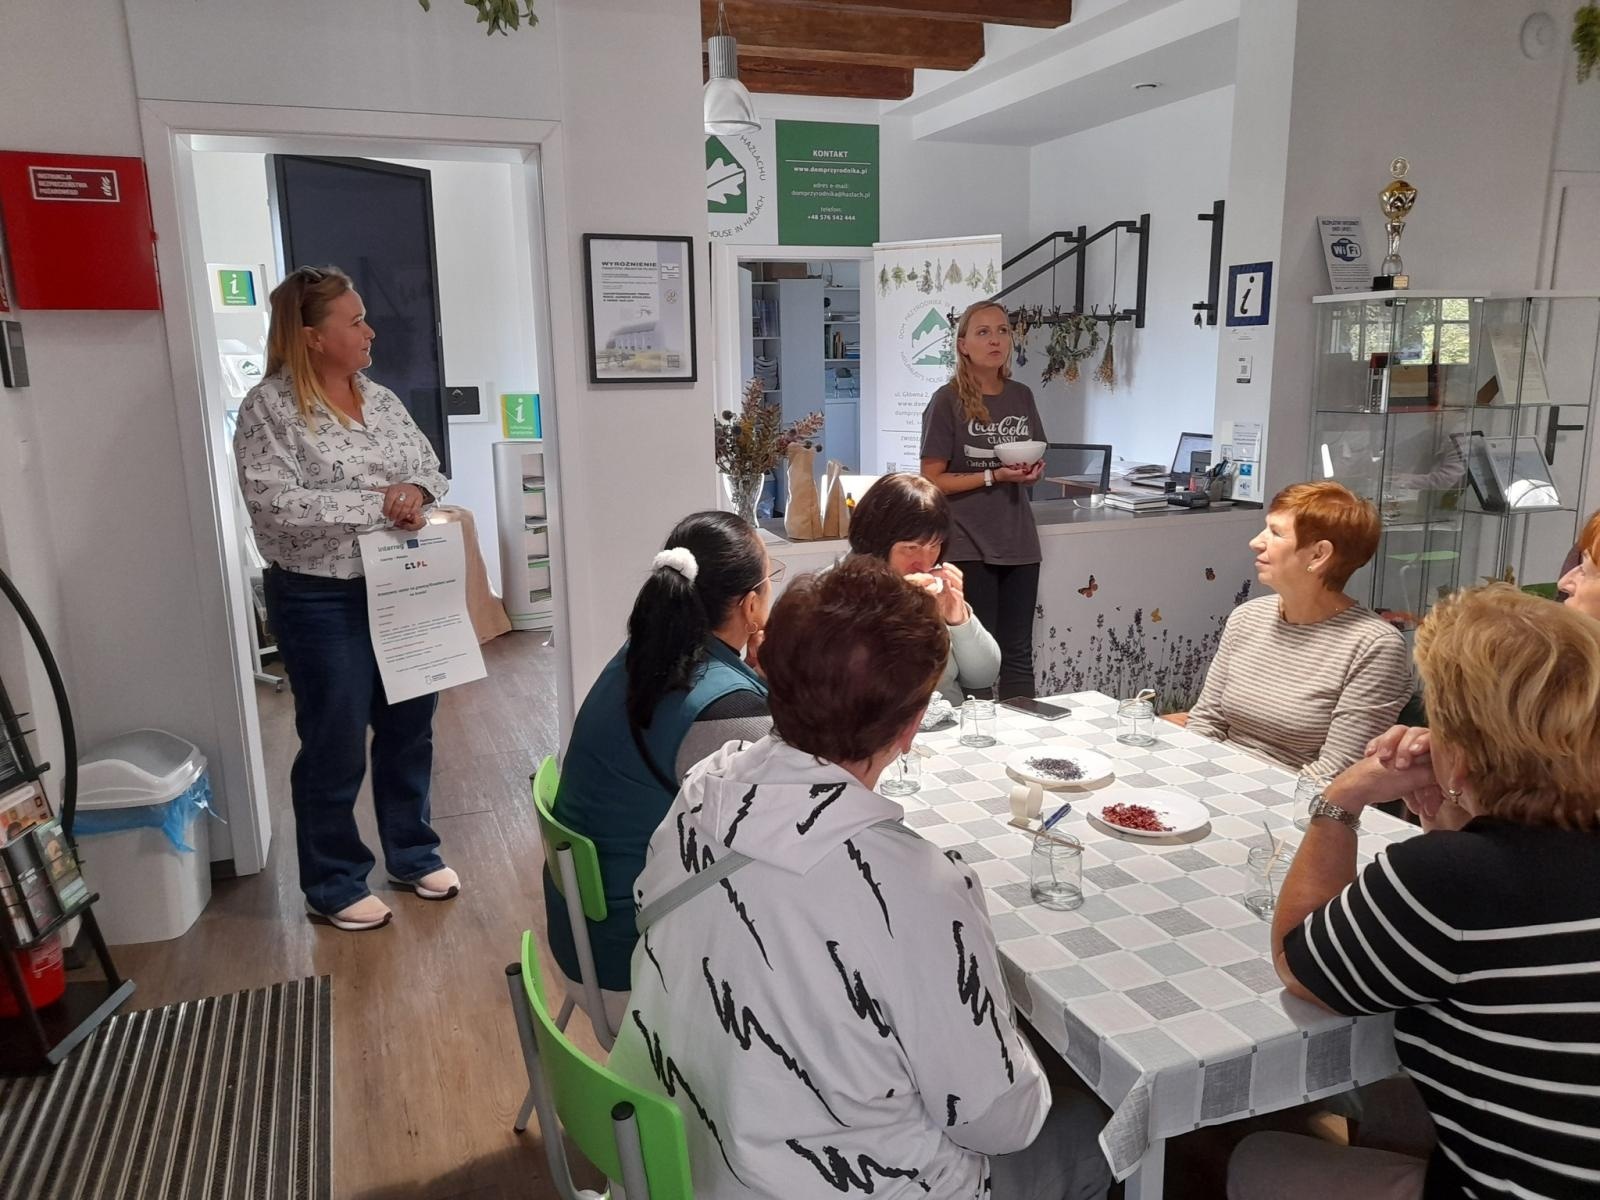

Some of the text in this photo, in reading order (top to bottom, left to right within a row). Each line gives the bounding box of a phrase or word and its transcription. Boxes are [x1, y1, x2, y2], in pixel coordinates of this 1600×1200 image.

[812, 149, 849, 158] KONTAKT
[793, 166, 868, 175] www.domprzyrodnika.pl
[967, 415, 1029, 437] Coca-Cola
